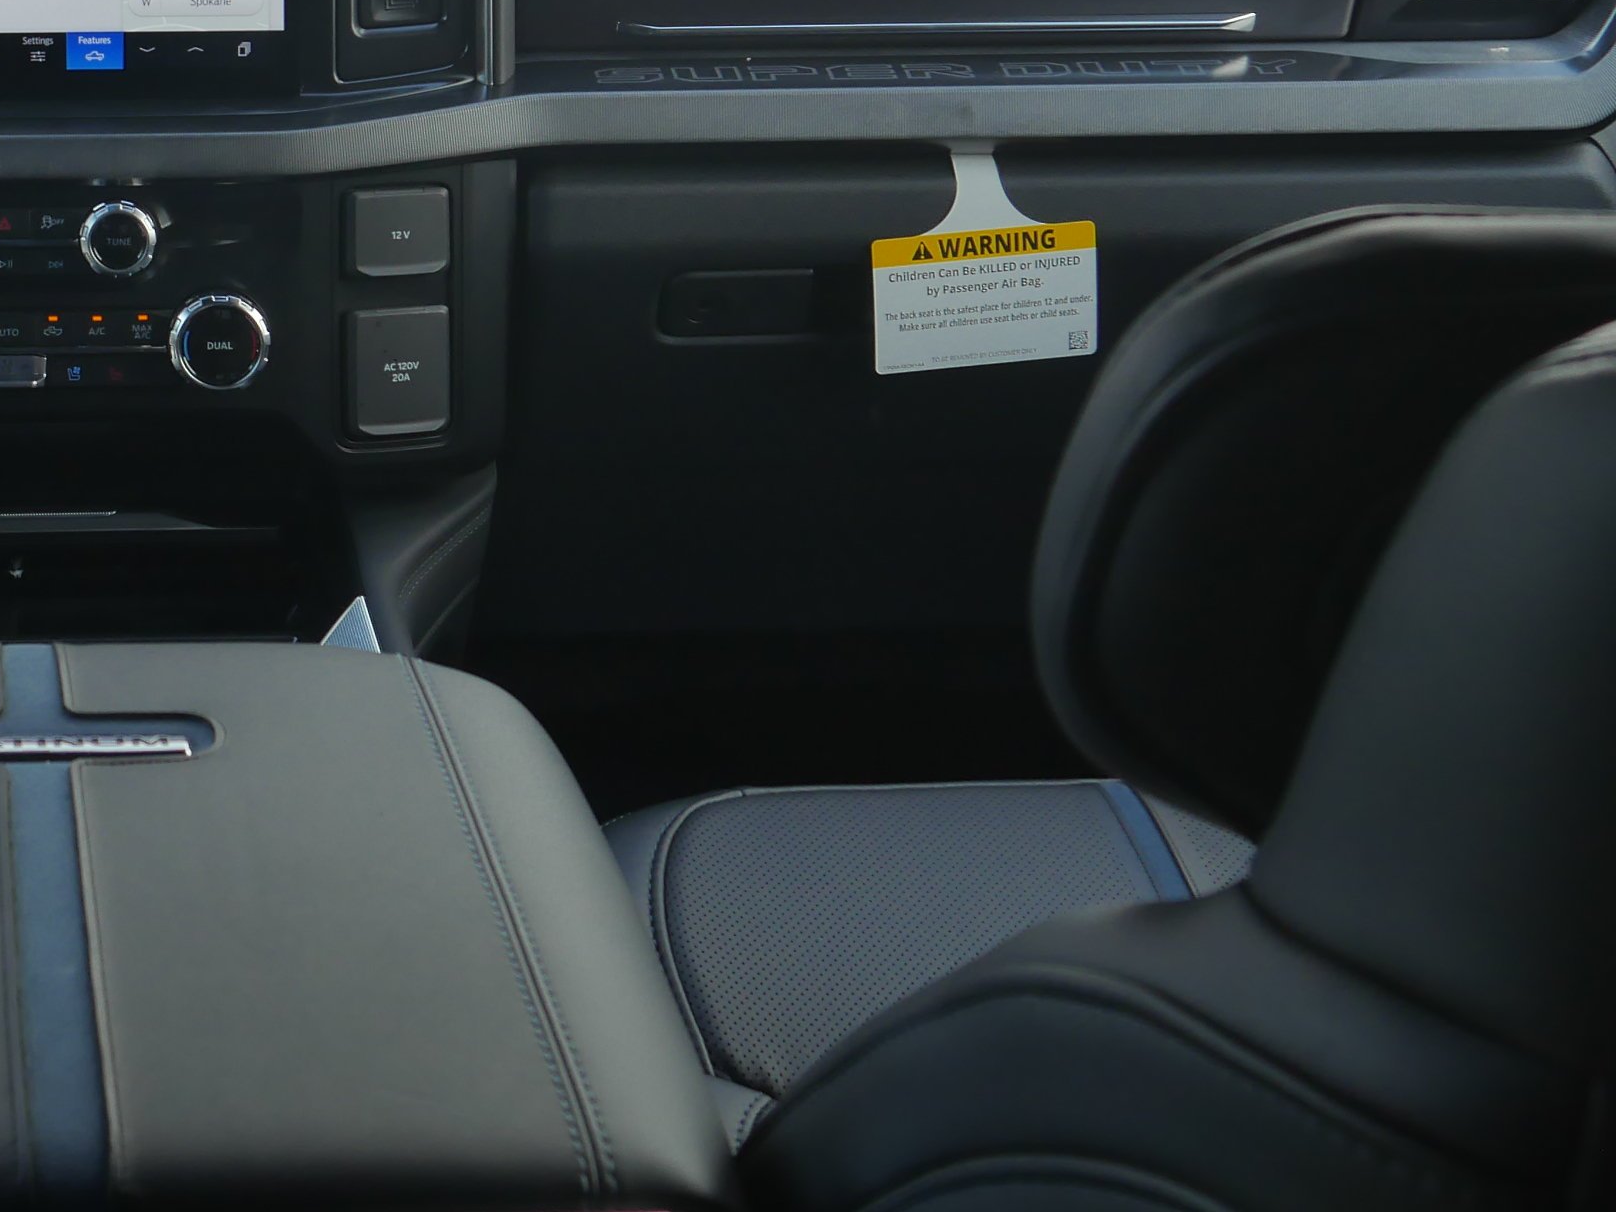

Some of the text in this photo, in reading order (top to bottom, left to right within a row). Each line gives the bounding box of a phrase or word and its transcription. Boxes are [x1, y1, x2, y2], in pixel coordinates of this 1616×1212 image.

[22, 36, 54, 46] Settings
[78, 36, 111, 45] Features
[594, 58, 1297, 84] SUPER DUTY
[391, 230, 411, 240] 12 V
[107, 237, 132, 246] TUNE
[938, 229, 1057, 259] WARNING
[888, 255, 1081, 283] Children Can Be KILLED or INJURED
[926, 277, 1044, 298] by Passenger Air Bag.
[885, 294, 1094, 321] The back seat is the safest place for children 12 and under.
[899, 307, 1080, 332] Make sure all children use seat belts or child seats.
[88, 326, 106, 335] A/C
[132, 324, 152, 332] MAX
[206, 341, 233, 350] DUAL
[384, 361, 420, 372] AC 120V
[392, 372, 411, 382] 20A
